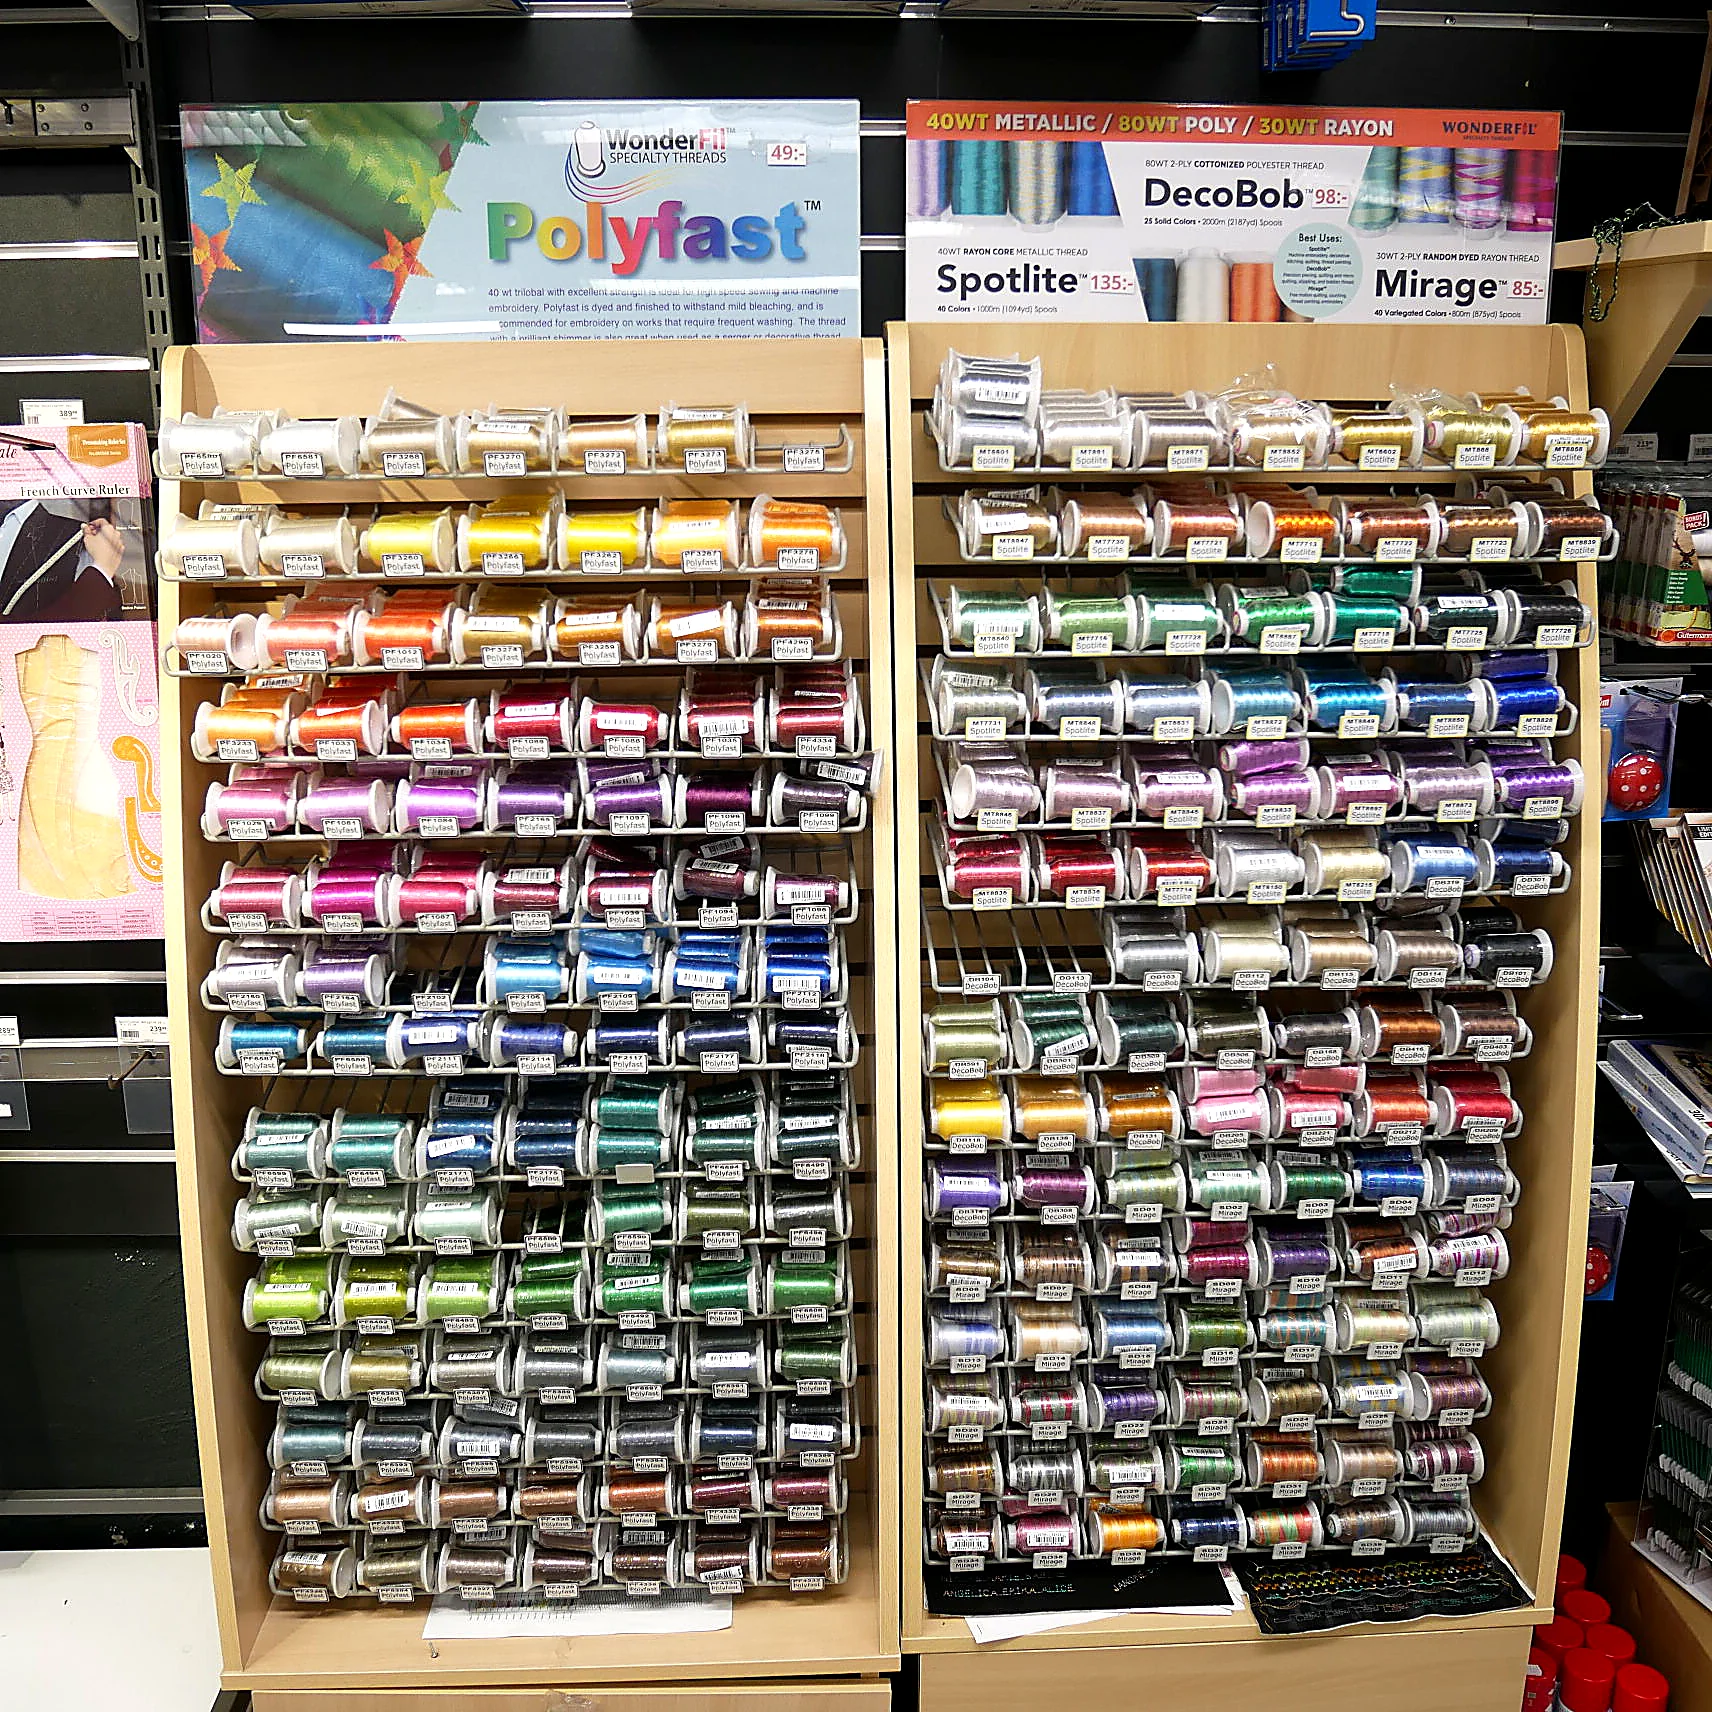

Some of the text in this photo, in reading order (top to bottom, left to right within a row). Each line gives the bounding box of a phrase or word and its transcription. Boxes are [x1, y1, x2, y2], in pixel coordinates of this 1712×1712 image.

[926, 113, 1393, 136] 40WT METALLIC 80WT POLY 30WT RAYON
[607, 128, 726, 150] WonderFil
[772, 145, 804, 160] 49:-
[610, 152, 726, 163] SPECIALTY THREADS
[1293, 162, 1324, 170] THREAD
[1315, 189, 1347, 204] 98:-
[1299, 233, 1342, 243] Best Uses:
[1091, 275, 1133, 291] 135:-
[547, 288, 565, 296] with
[568, 288, 607, 296] excellent
[1513, 281, 1543, 296] 85:-
[544, 304, 579, 312] Polyfast
[592, 304, 613, 312] dyed
[684, 302, 725, 311] withstand
[728, 302, 746, 310] mild
[797, 302, 813, 310] and
[817, 302, 824, 310] is
[1385, 310, 1423, 318] Variegated
[555, 319, 566, 327] for
[570, 319, 619, 328] embroidery
[636, 318, 662, 327] works
[665, 318, 681, 326] that
[684, 318, 714, 327] require
[718, 318, 754, 327] frequent
[799, 317, 815, 325] The
[818, 317, 845, 325] thread
[1365, 455, 1395, 464] Spotlite
[286, 462, 319, 470] Polyfast
[588, 461, 621, 469] Polyfast
[689, 460, 721, 468] Polyfast
[62, 485, 97, 495] Curve
[99, 484, 130, 496] Ruler
[1477, 547, 1506, 555] Spotlite
[1566, 546, 1595, 555] Spotlite
[1452, 636, 1481, 645] Spotlite
[1541, 635, 1570, 643] Spotlite
[192, 660, 224, 669] Polyfast
[290, 658, 321, 666] Polyfast
[971, 727, 1001, 736] Spotlite
[415, 747, 446, 755] Polyfast
[801, 745, 832, 753] Polyfast
[614, 822, 645, 830] Polyfast
[1517, 884, 1548, 892] DecoBob
[1163, 893, 1192, 901] Spotlite
[609, 916, 640, 924] Polyfast
[1413, 977, 1444, 985] DecoBob
[787, 997, 817, 1005] Polyfast
[704, 1060, 734, 1068] Polyfast
[1389, 1134, 1420, 1142] DecoBob
